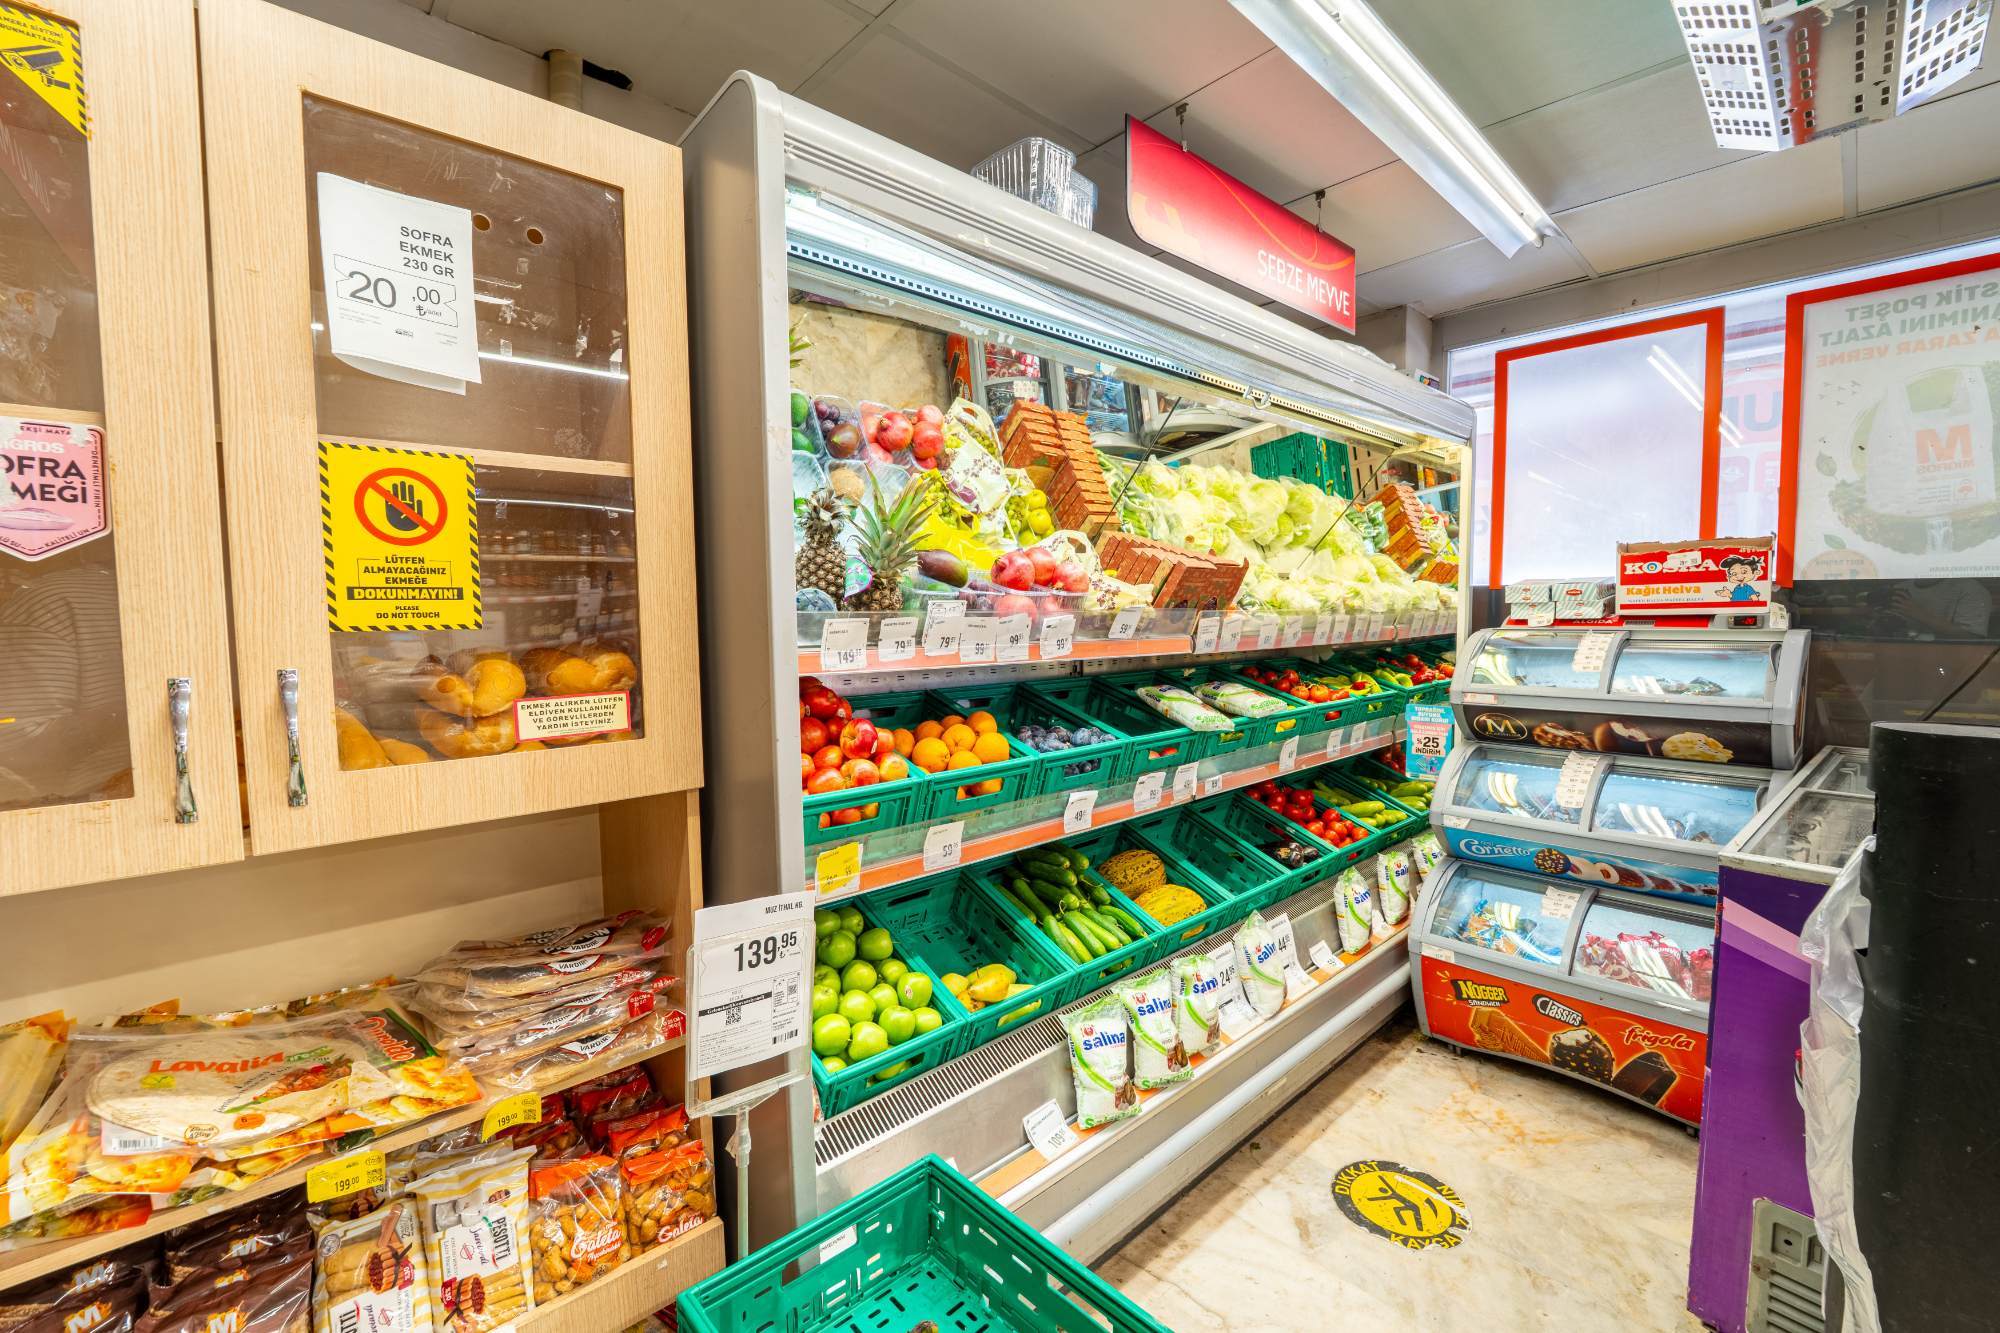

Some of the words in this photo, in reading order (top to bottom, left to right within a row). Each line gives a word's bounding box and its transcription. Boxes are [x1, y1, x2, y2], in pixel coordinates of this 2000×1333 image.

[400, 226, 453, 249] SOFRA
[400, 241, 454, 264] EKMEK
[403, 257, 428, 272] 230
[433, 264, 455, 279] GR
[348, 271, 397, 309] 20
[1257, 249, 1303, 294] SEBZE
[1306, 272, 1350, 316] MEYVE
[385, 554, 425, 565] LÜTFEN
[363, 565, 447, 576] ALMAYACAĞINIZ
[385, 575, 428, 585] EKMEĞE
[353, 587, 459, 600] DOKUNMAYIN!
[1626, 585, 1661, 597] Kağıt
[1662, 585, 1701, 596] Helva
[411, 611, 440, 619] TOUCH
[520, 702, 552, 711] EKMEK
[554, 699, 590, 707] ALIRKEN
[529, 707, 565, 717] ELDİVEN
[567, 704, 617, 713] KULLANINIZ
[536, 722, 569, 731] YARDIM
[1459, 838, 1531, 858] Cornetto
[765, 905, 778, 915] MUZ
[1457, 980, 1508, 1001] NOGGER
[1468, 999, 1501, 1007] SANDWICH
[1536, 996, 1582, 1027] Classics
[1082, 1031, 1126, 1051] salina
[1623, 1025, 1697, 1052] frigola
[657, 1216, 703, 1243] Galeta
[570, 1228, 622, 1259] Galeta
